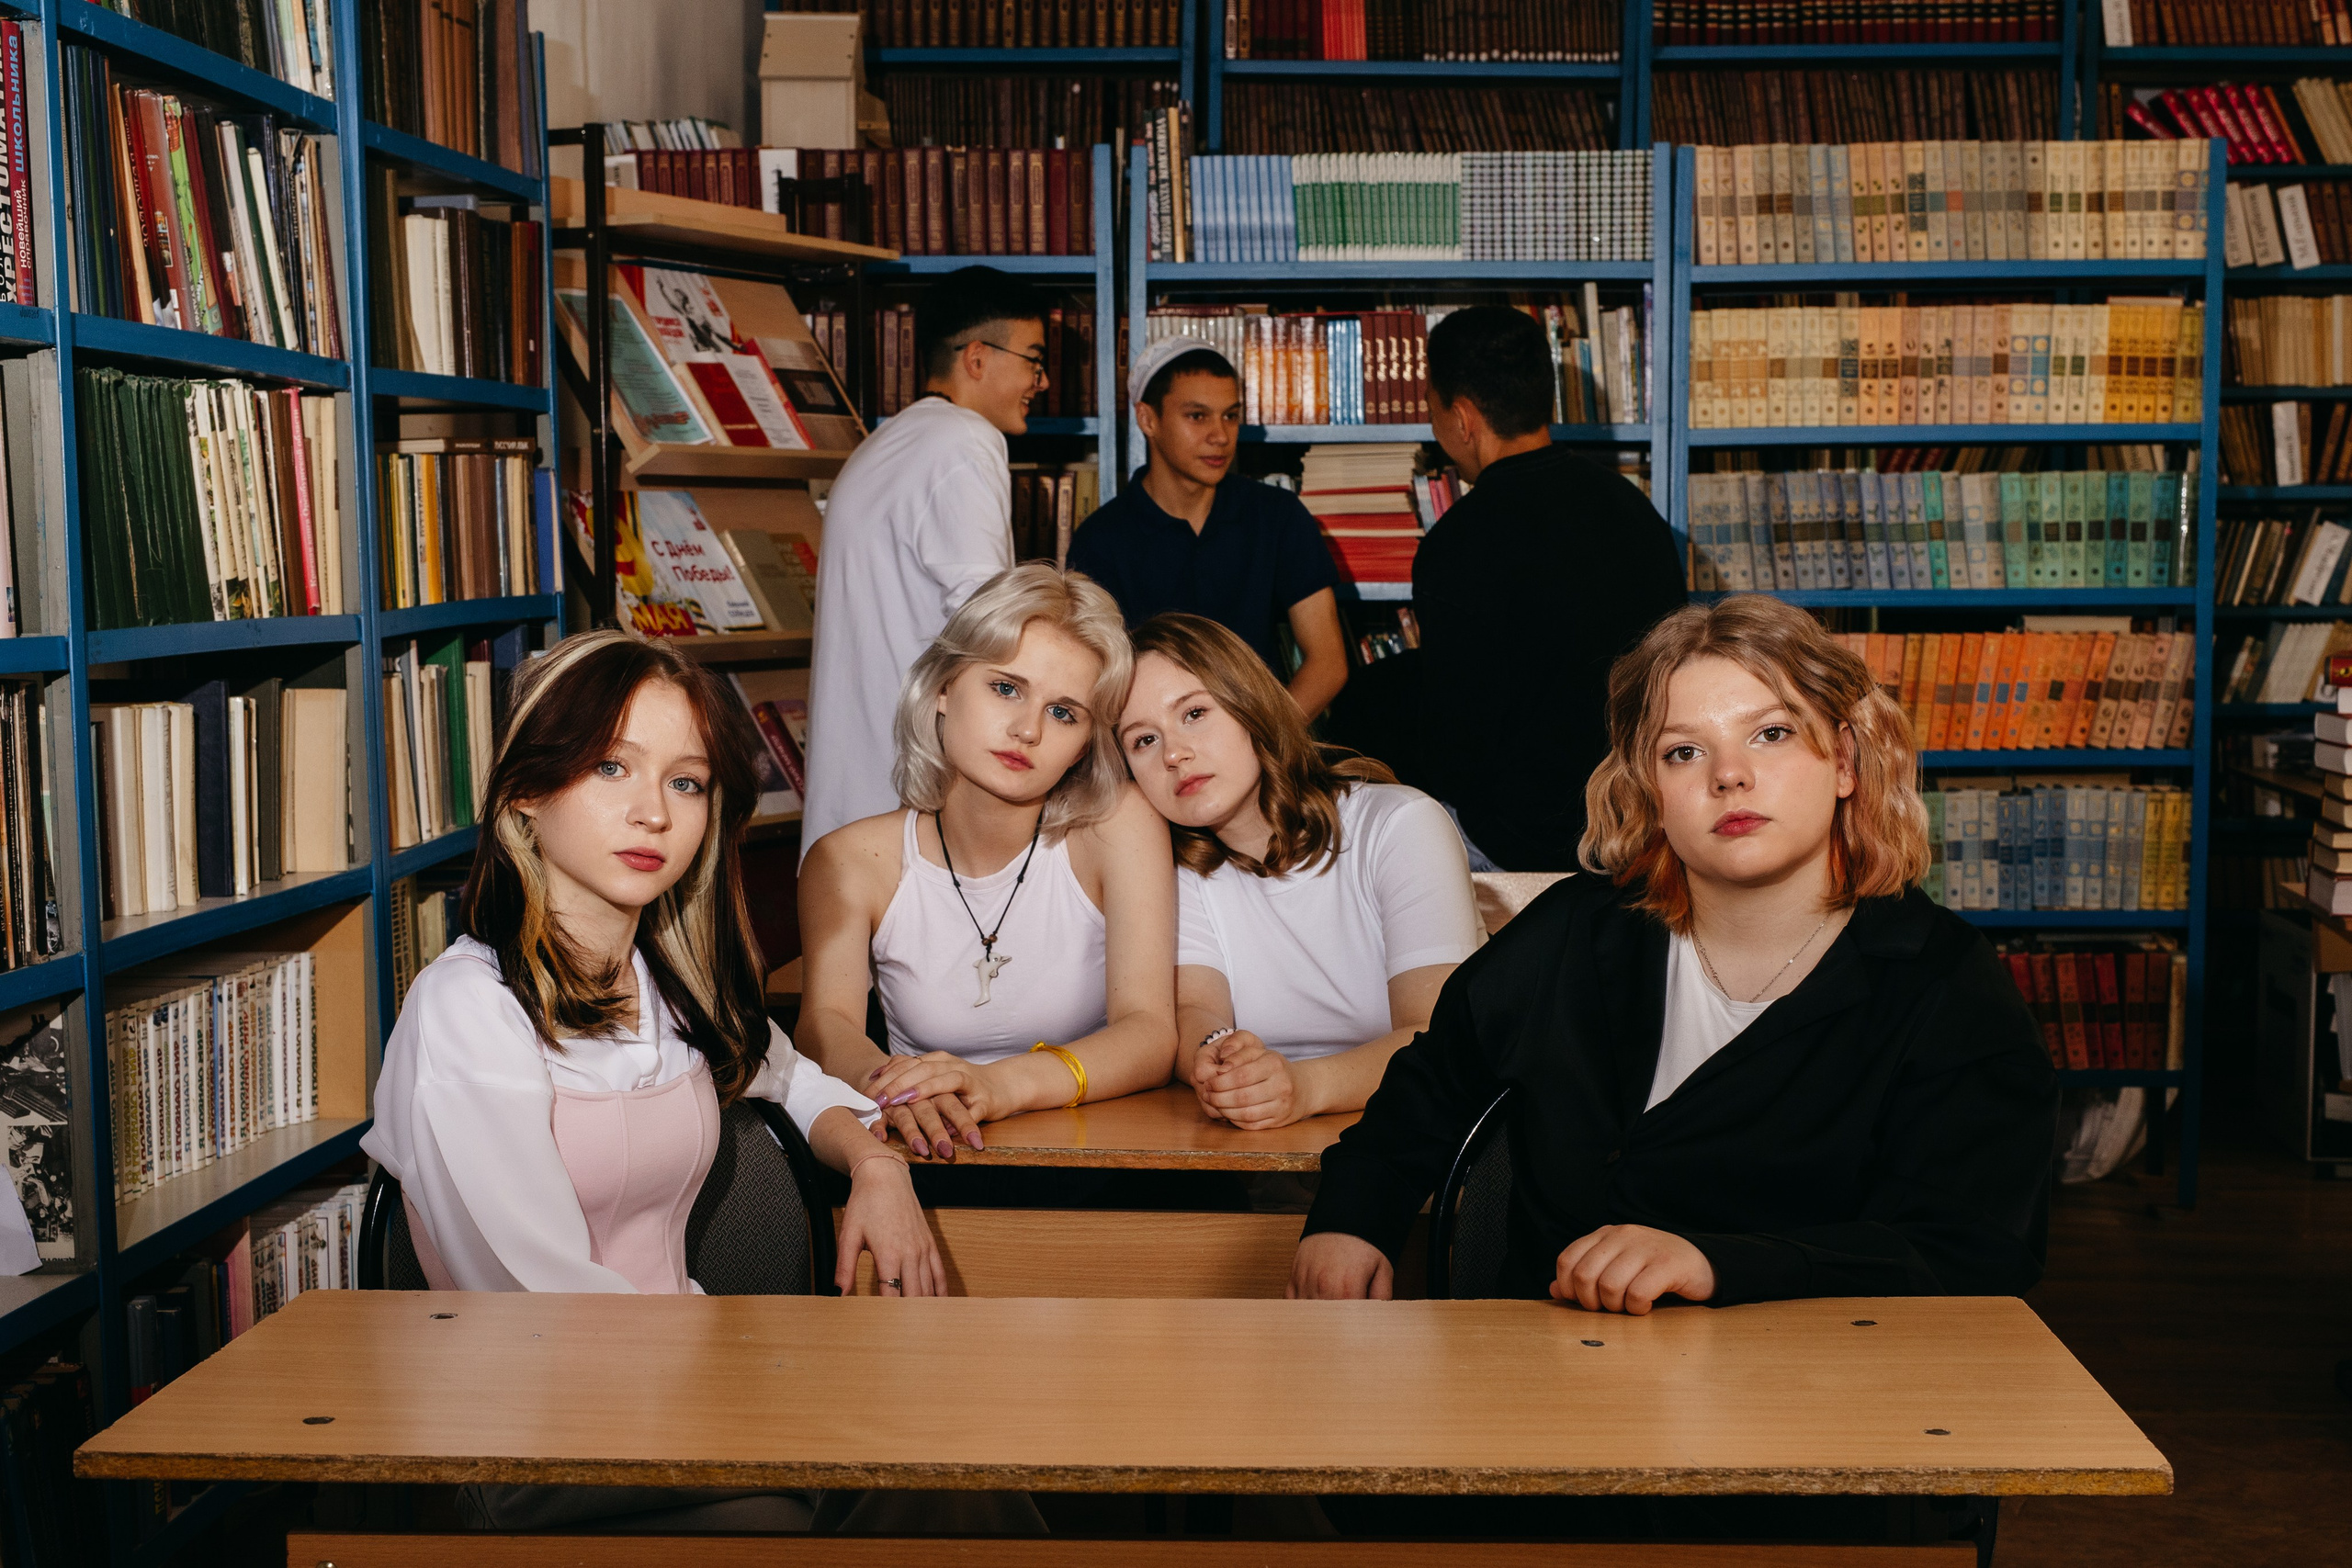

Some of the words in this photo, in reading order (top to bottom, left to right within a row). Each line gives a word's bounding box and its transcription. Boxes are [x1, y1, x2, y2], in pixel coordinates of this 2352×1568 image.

[8, 35, 24, 173] школьника
[14, 190, 27, 269] новейший
[20, 179, 32, 270] справочник
[650, 540, 664, 557] С
[664, 539, 705, 558] Днём
[672, 564, 734, 583] Победы!
[628, 601, 690, 631] МАЯ
